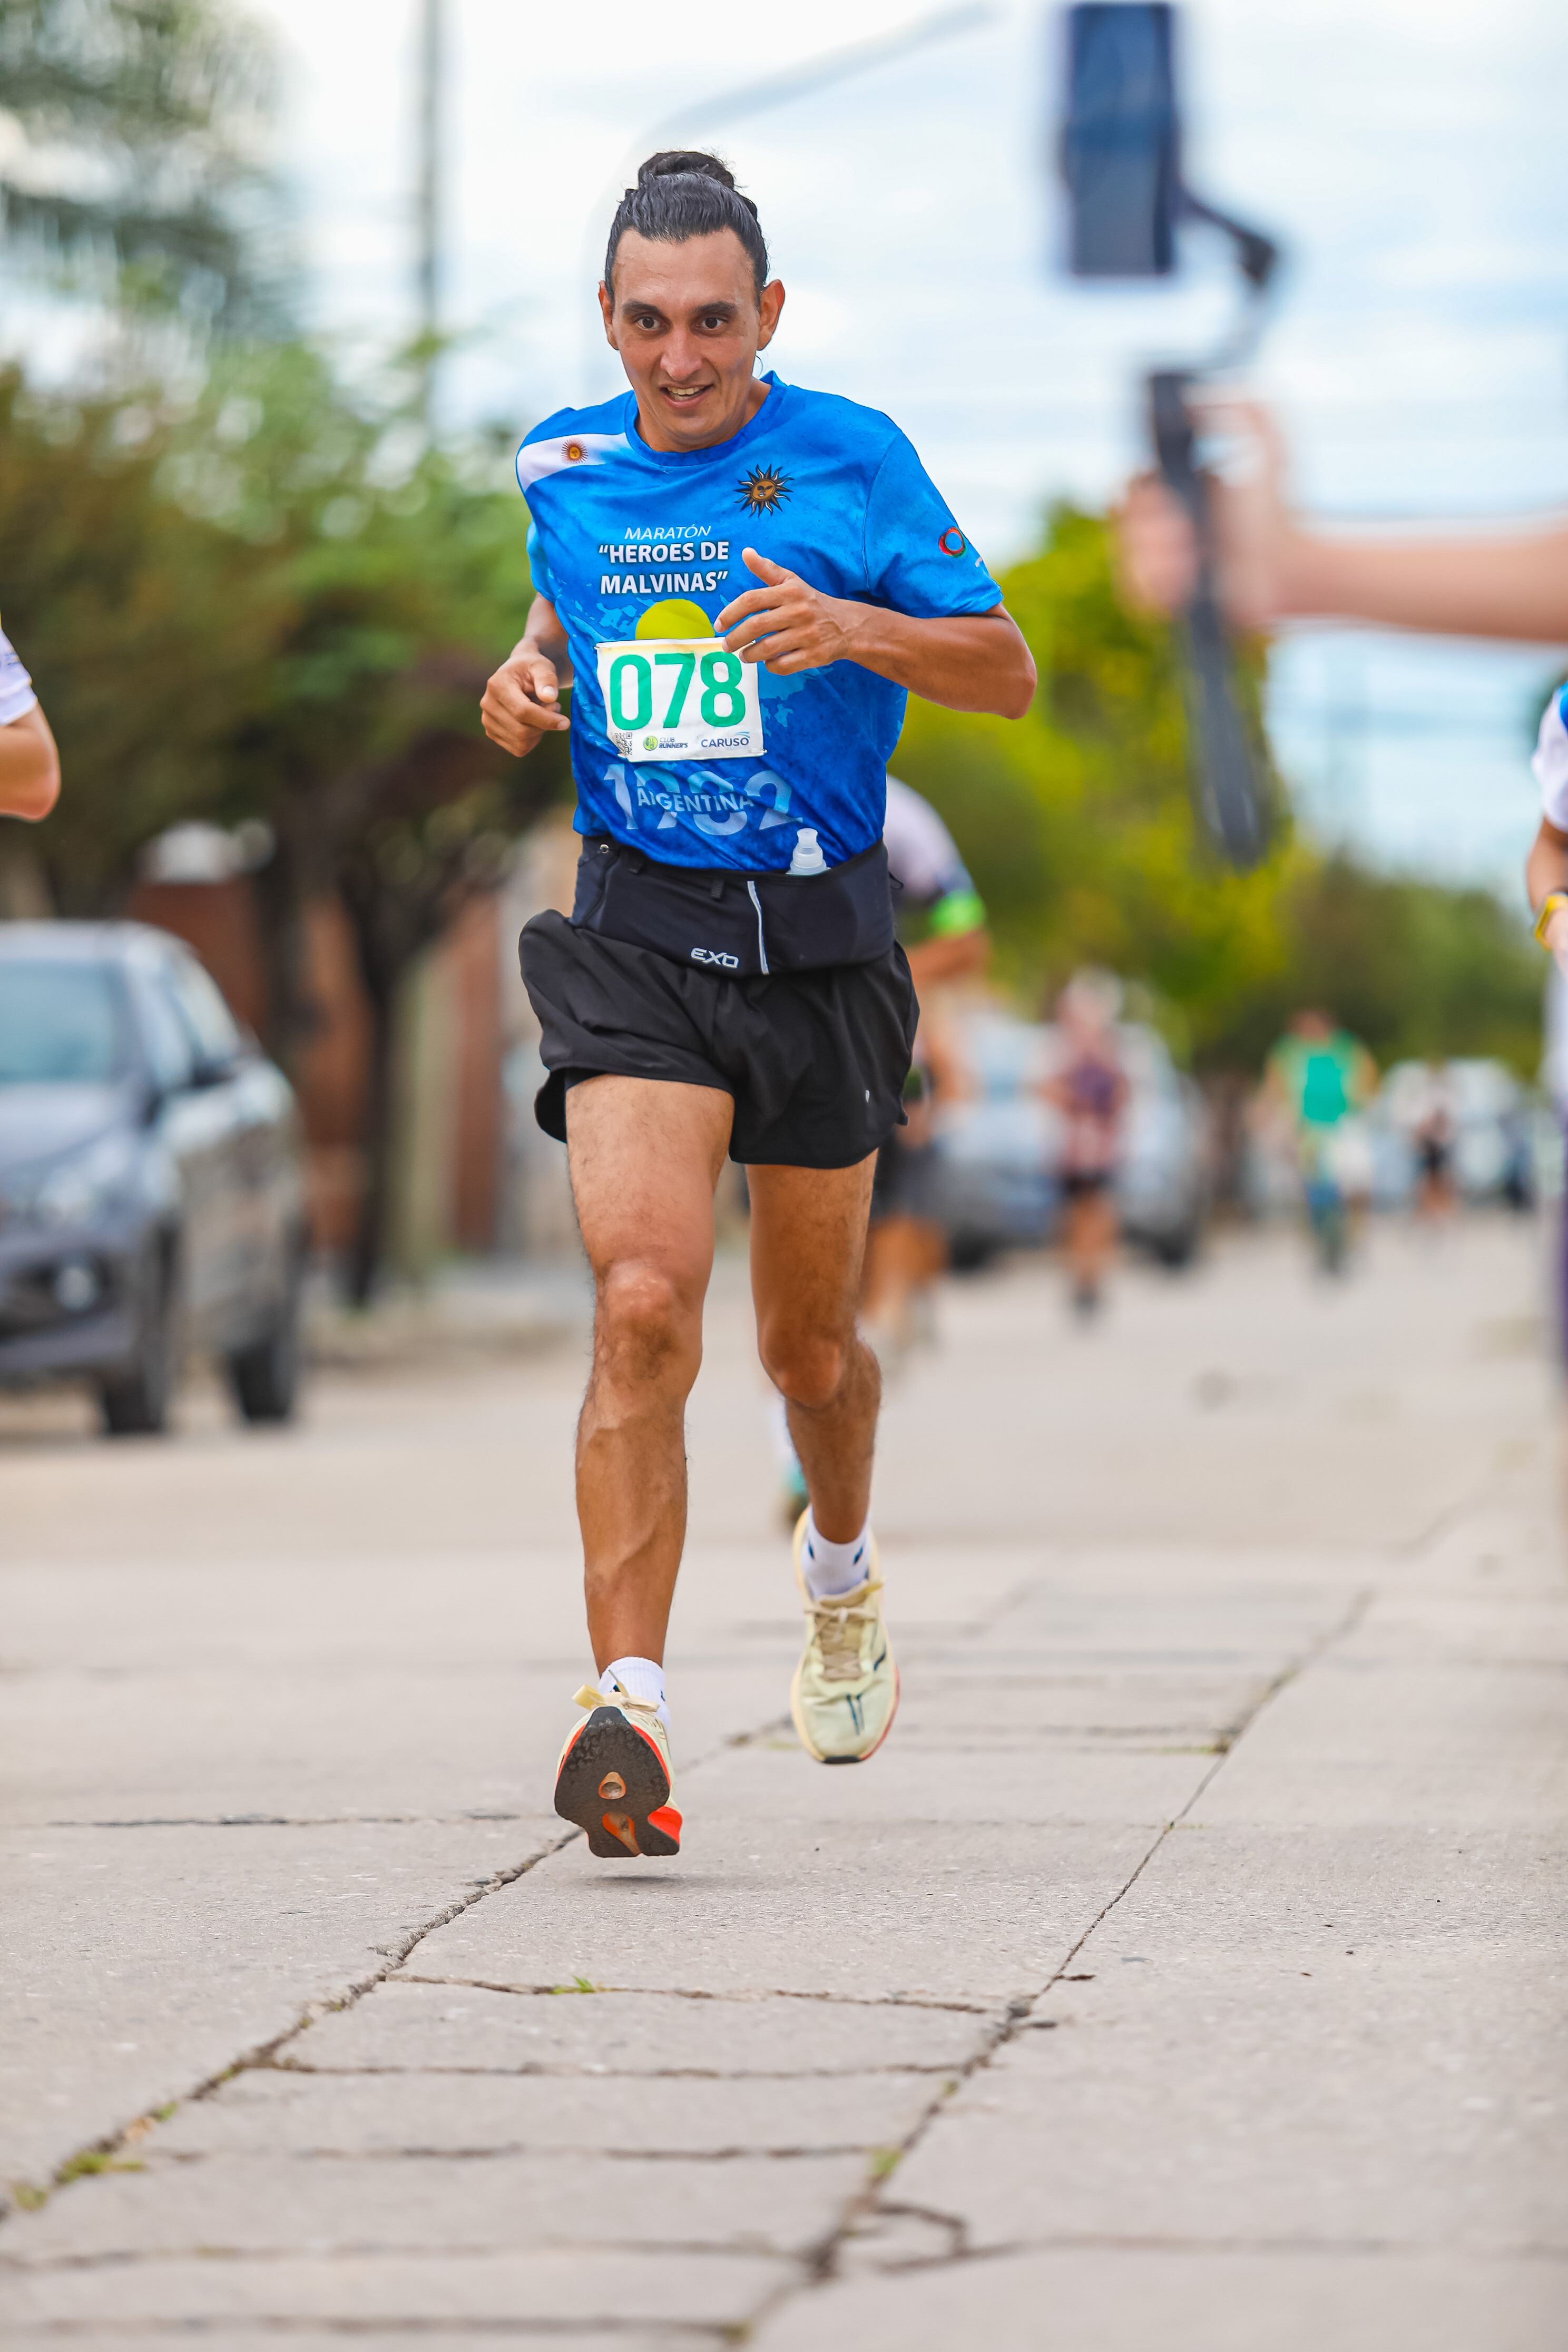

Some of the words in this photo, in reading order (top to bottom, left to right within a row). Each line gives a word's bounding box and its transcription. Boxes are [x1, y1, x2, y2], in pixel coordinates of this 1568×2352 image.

[624, 524, 711, 540] MARATÓN
[700, 541, 729, 561] DE
[609, 652, 746, 731] 078
[701, 738, 749, 748] CARUSO
[691, 947, 739, 968] EXO
